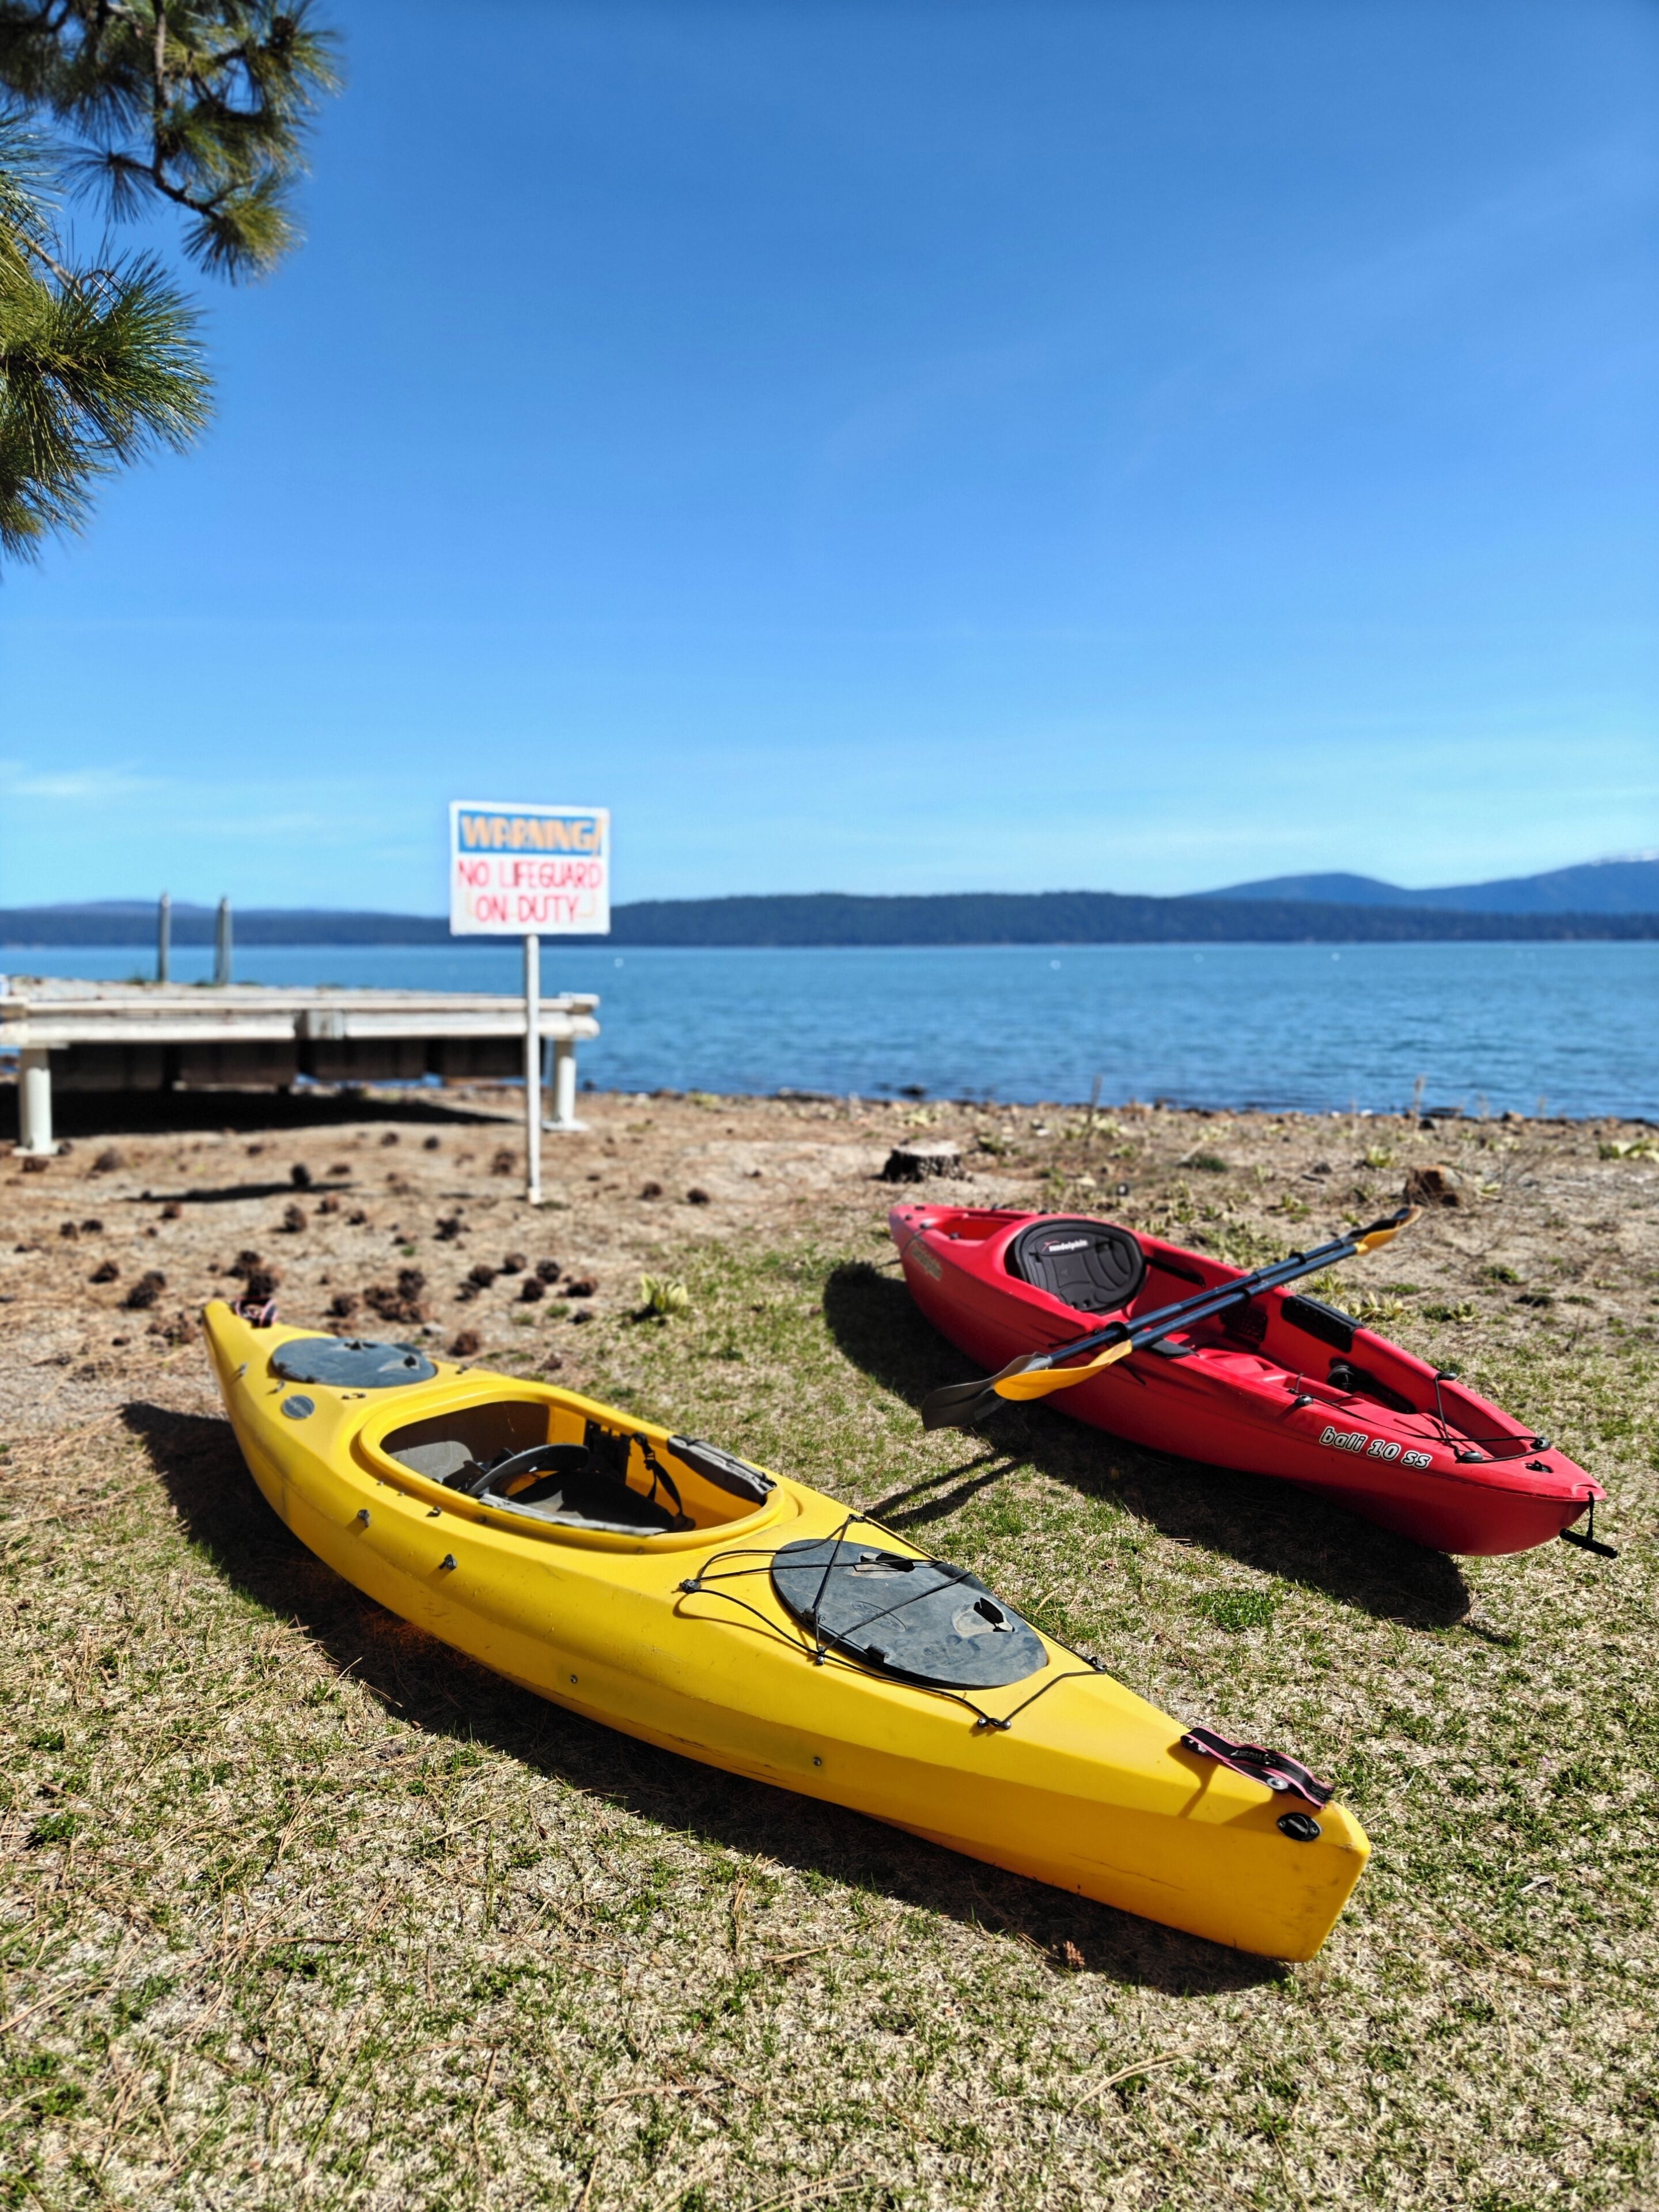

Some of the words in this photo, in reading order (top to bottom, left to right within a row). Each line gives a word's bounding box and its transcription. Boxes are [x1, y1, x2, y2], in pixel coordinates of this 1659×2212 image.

[459, 860, 489, 888] NO
[500, 861, 601, 889] LIFEGUARD
[476, 895, 506, 922] ON
[519, 895, 579, 922] DUTY
[1320, 1426, 1368, 1453] bali
[1366, 1440, 1402, 1461] 10
[1400, 1450, 1433, 1469] ss
